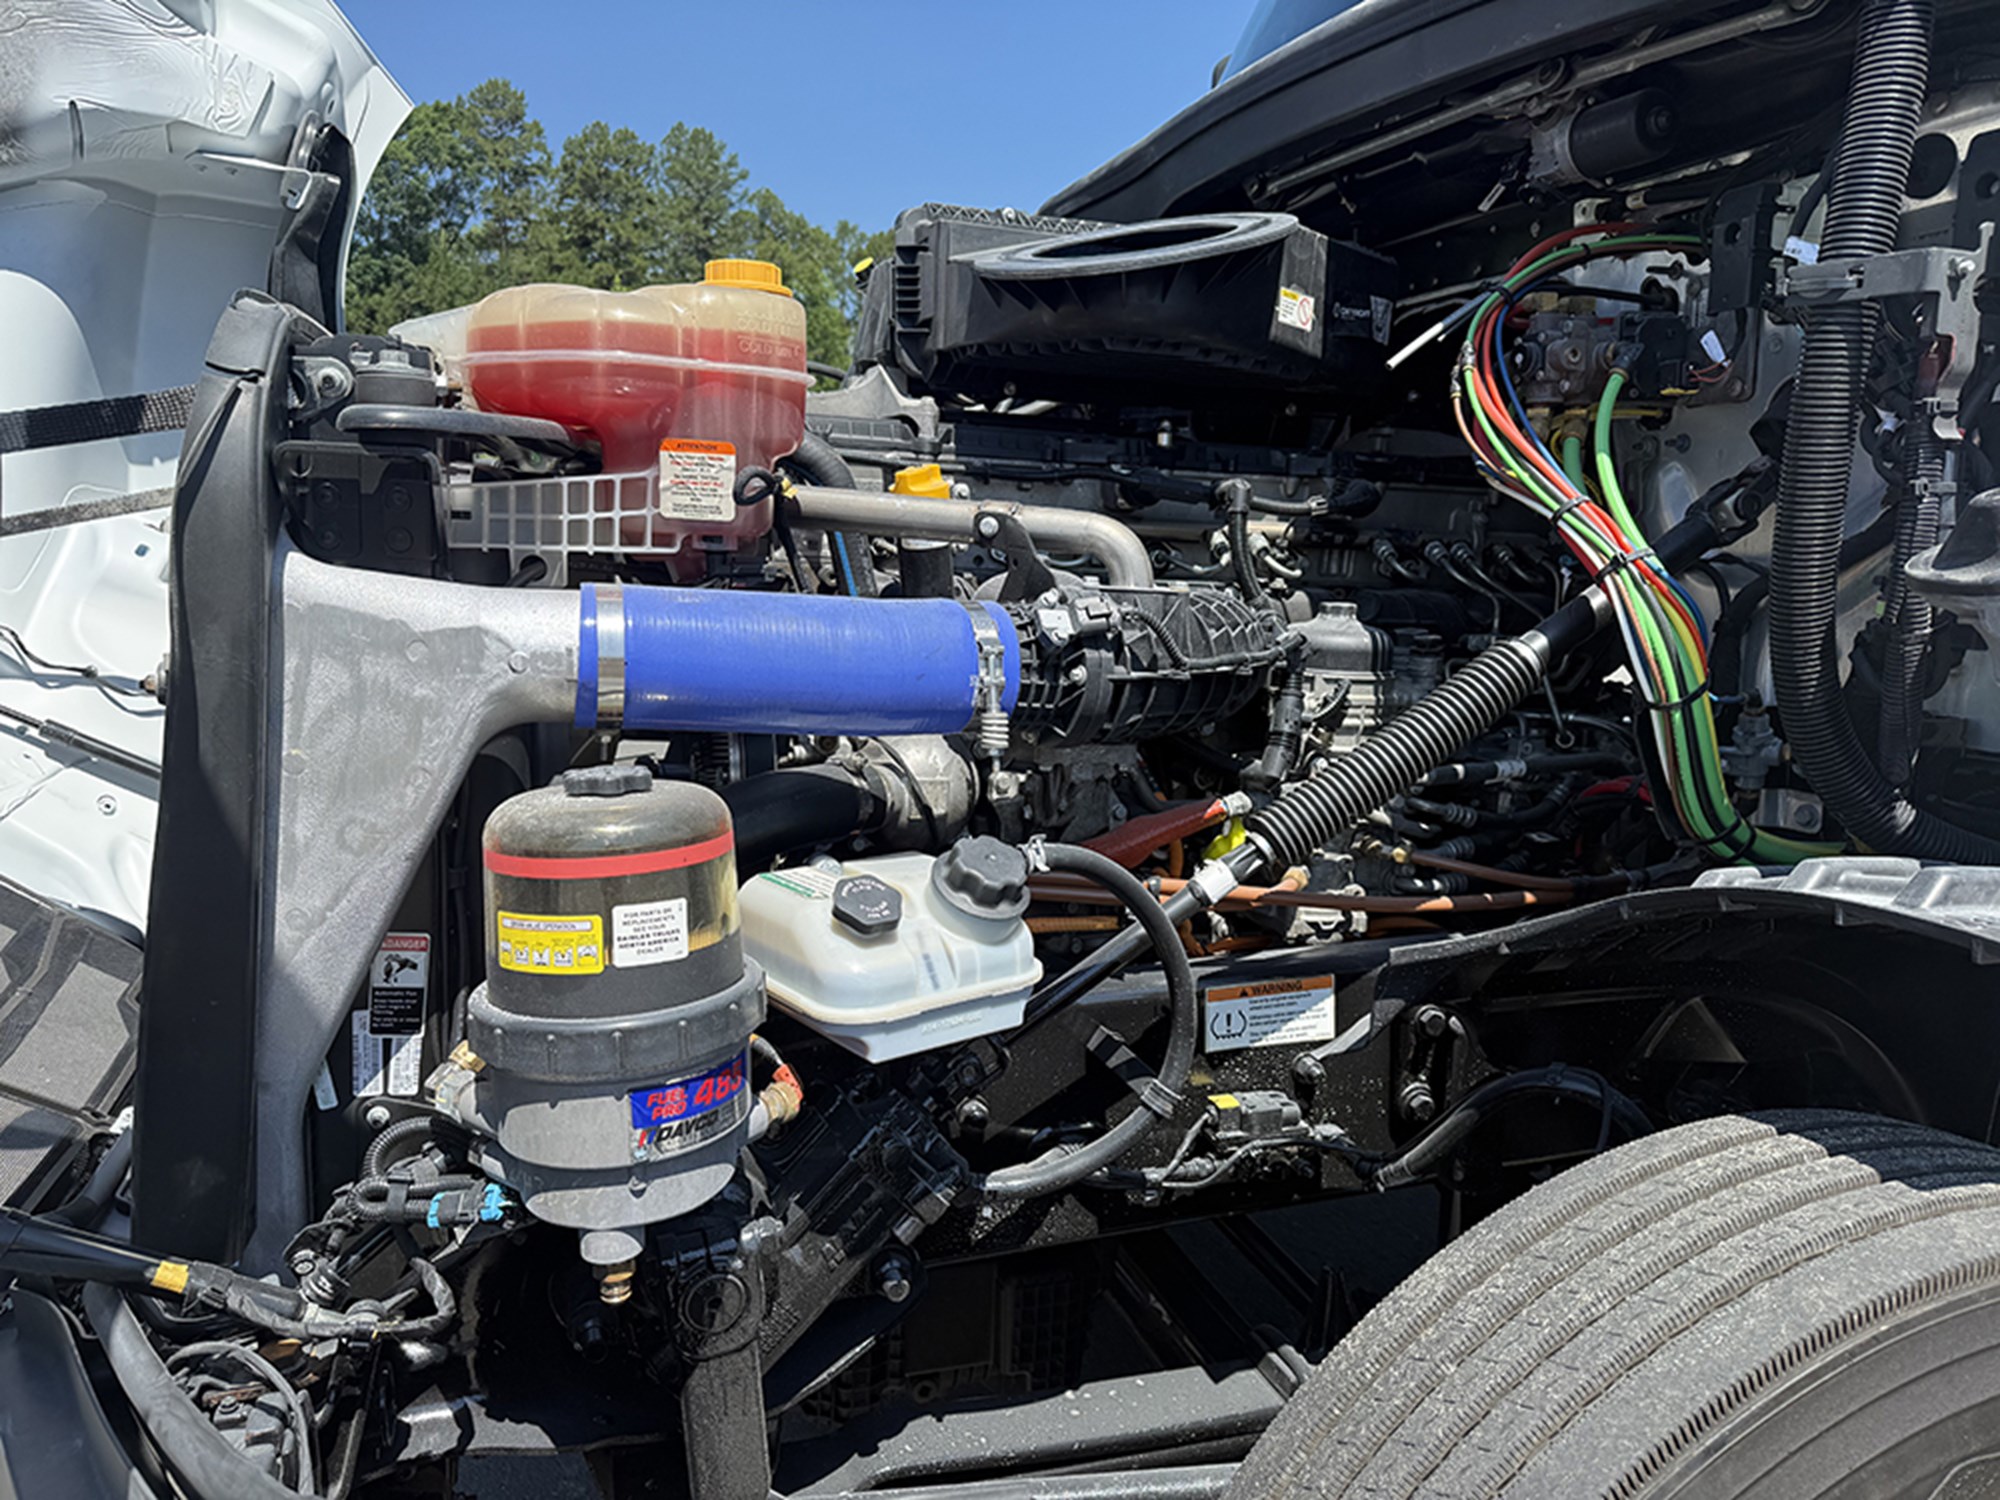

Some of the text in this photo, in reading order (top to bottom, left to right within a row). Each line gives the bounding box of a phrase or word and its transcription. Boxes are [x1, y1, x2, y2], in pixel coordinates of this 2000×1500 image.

[738, 339, 773, 355] COLD
[385, 938, 428, 949] DANGER
[1253, 980, 1302, 995] WARNING
[694, 1059, 743, 1106] 485
[647, 1087, 688, 1108] FUEL
[651, 1101, 687, 1121] PRO
[655, 1109, 719, 1142] DAVCO
